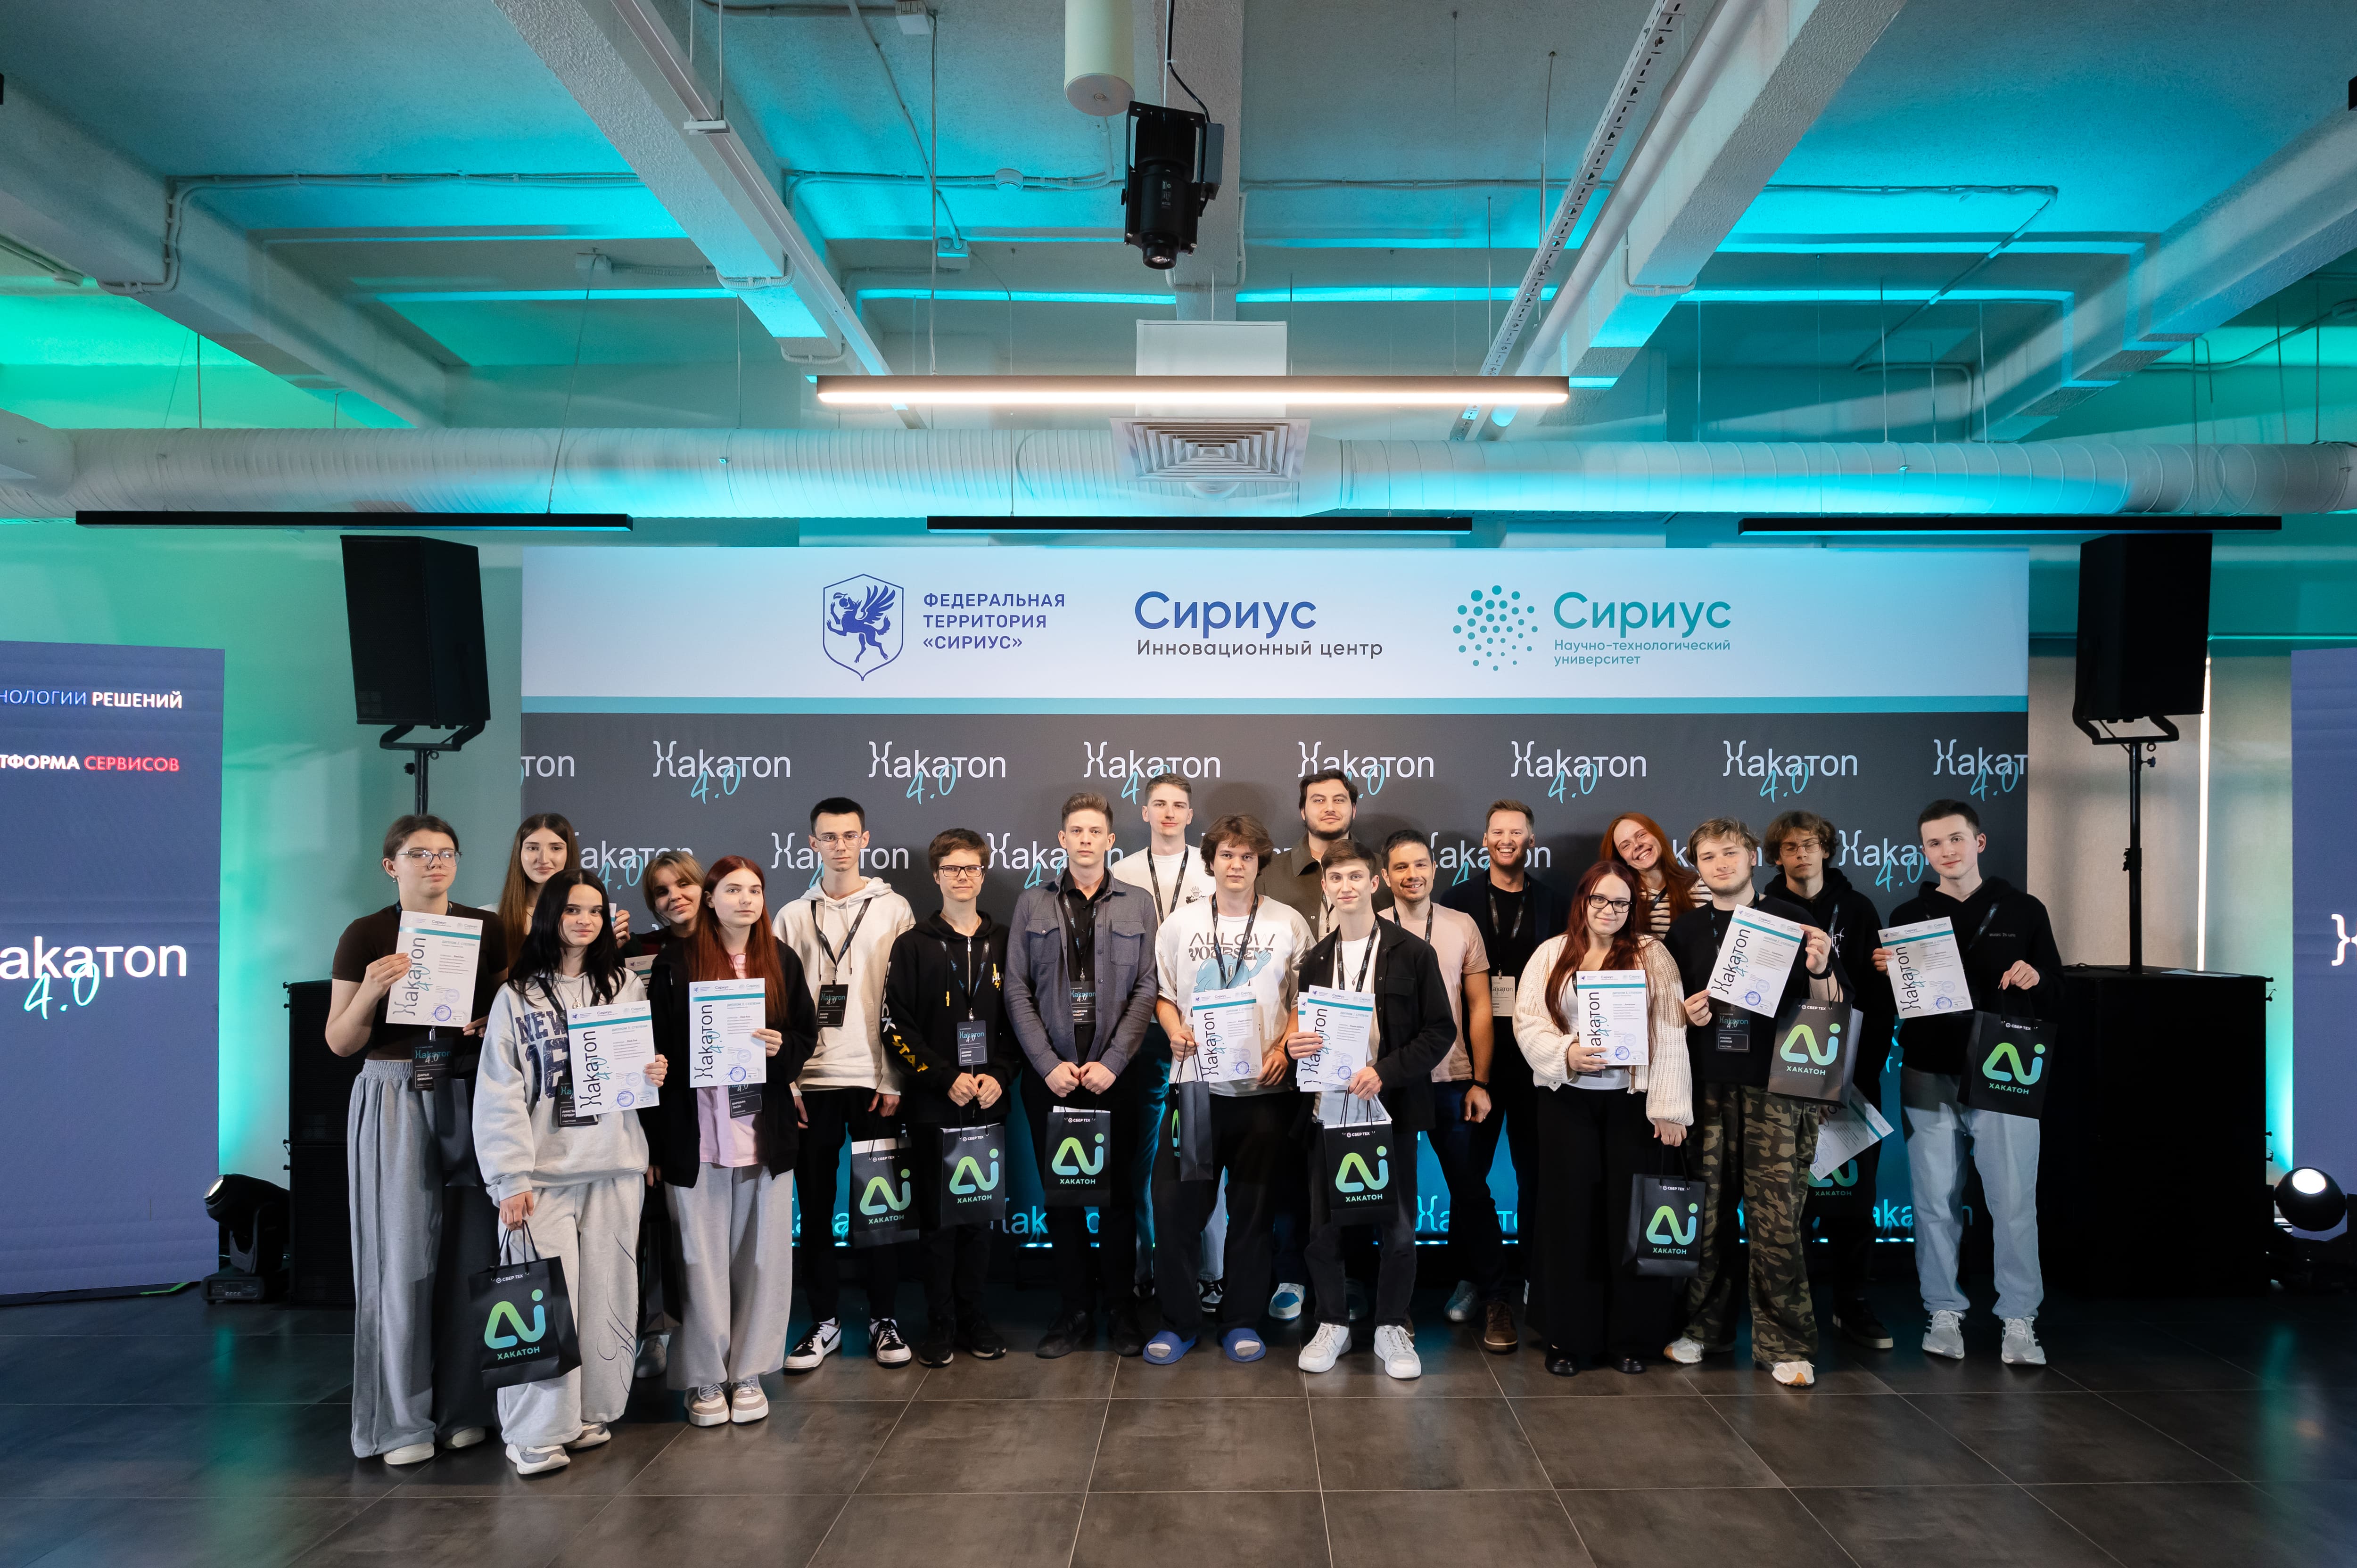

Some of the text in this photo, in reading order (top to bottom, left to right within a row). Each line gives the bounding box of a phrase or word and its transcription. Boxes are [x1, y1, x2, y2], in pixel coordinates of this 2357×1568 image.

[923, 593, 1065, 608] ФЕДЕРАЛЬНАЯ
[923, 615, 1047, 628] ТЕРРИТОРИЯ
[1135, 591, 1317, 639] Сириус
[1554, 591, 1731, 638] Сириус
[923, 636, 1022, 649] «СИРИУС»
[1137, 639, 1383, 659] Инновационный центр
[1555, 640, 1731, 653] Научно-технологический
[1554, 656, 1640, 667] университет
[92, 691, 182, 708] РЕШЕНИЙ
[84, 755, 180, 772] СЕРВИСОВ
[691, 764, 741, 804] 4.0
[907, 764, 956, 805] 4.0
[1548, 763, 1598, 804] 4.0
[1760, 763, 1809, 803] 4.0
[1970, 762, 2019, 801] 4.0
[1876, 852, 1923, 892] 4.0
[1734, 953, 1748, 977] 4.0
[416, 966, 434, 991] 4.0
[1905, 969, 1926, 988] 4.0
[24, 962, 100, 1020] 4.0
[1596, 1016, 1611, 1036] 4.0
[706, 1031, 725, 1053] 4.0
[1209, 1034, 1227, 1054] 4.0
[590, 1058, 613, 1080] 4.0
[1787, 1066, 1826, 1075] ХАКАТОН
[1989, 1083, 2029, 1094] ХАКАТОН
[957, 1194, 992, 1204] ХАКАТОН
[1345, 1194, 1383, 1202] ХАКАТОН
[868, 1215, 904, 1224] ХАКАТОН
[497, 1346, 540, 1360] ХАКАТОН
